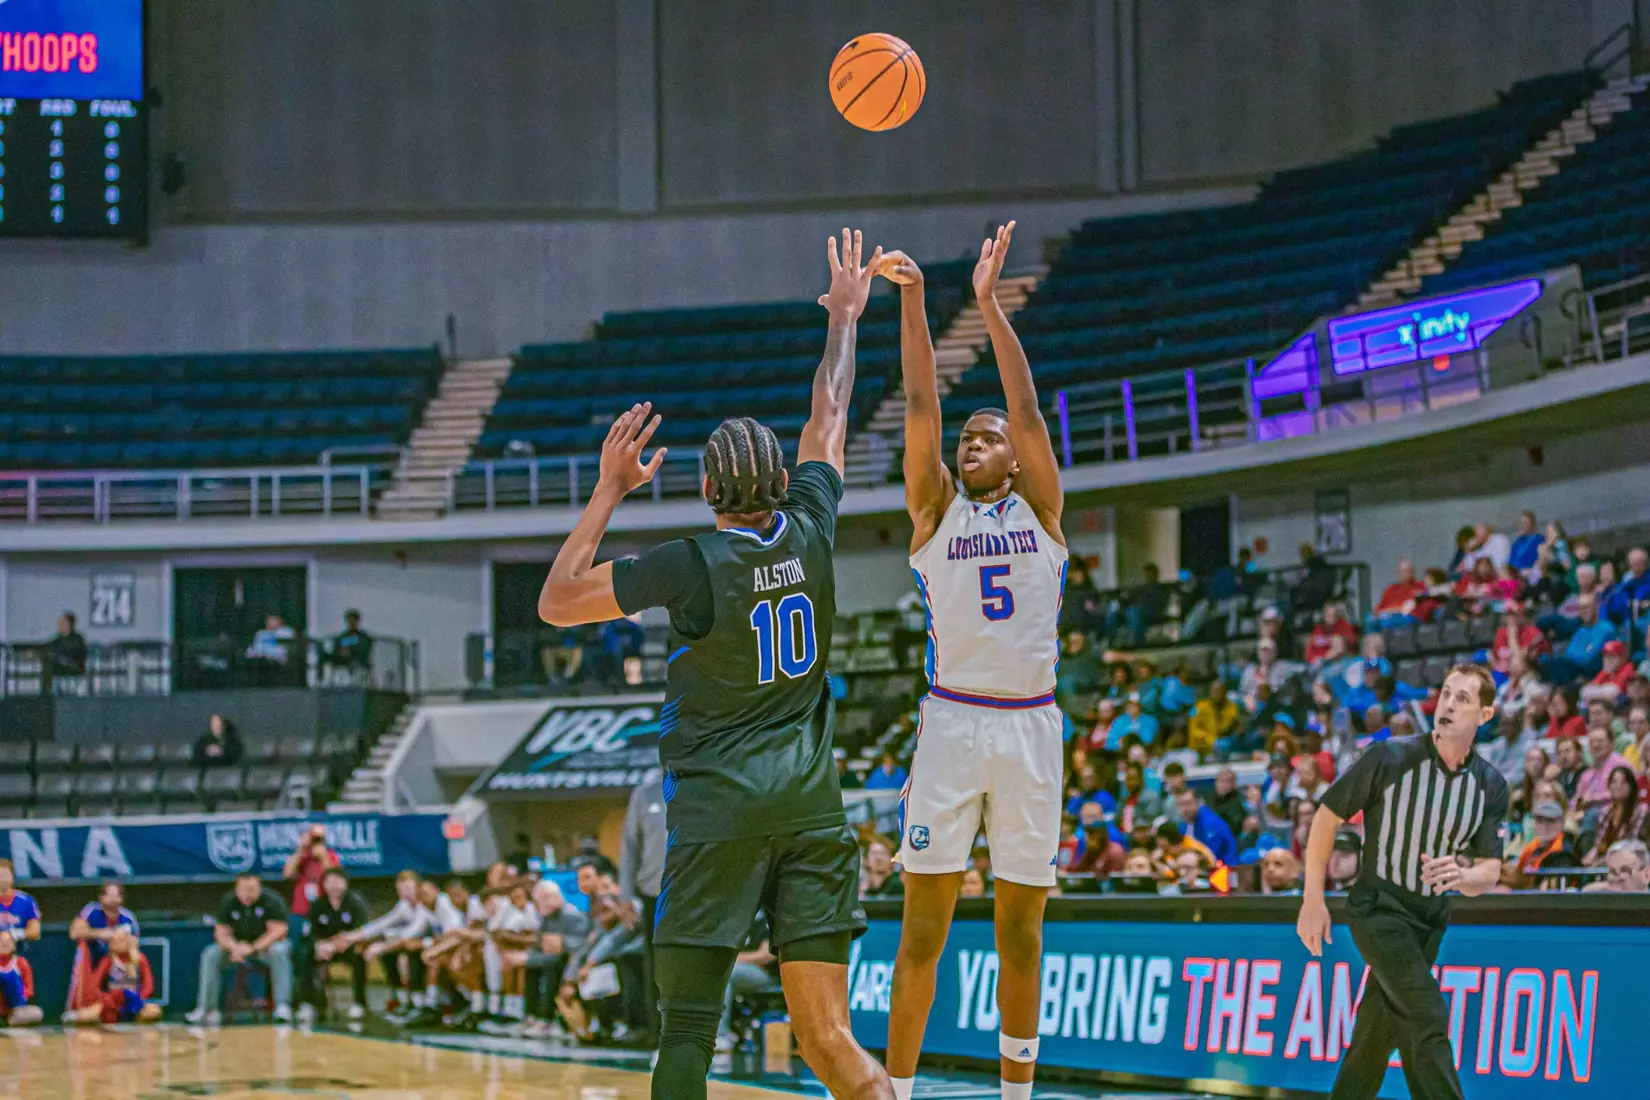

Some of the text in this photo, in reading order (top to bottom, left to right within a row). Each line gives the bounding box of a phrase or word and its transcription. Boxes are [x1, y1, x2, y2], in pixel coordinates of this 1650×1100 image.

[0, 32, 98, 73] HOOPS
[1007, 529, 1039, 554] TECH
[753, 557, 806, 592] ALSTON
[979, 563, 1015, 622] 5
[93, 587, 130, 624] 214
[749, 592, 818, 685] 10
[526, 707, 655, 754] VBC
[1036, 951, 1173, 1046] BRING
[1182, 956, 1282, 1057] THE
[1283, 959, 1600, 1084] AMTION
